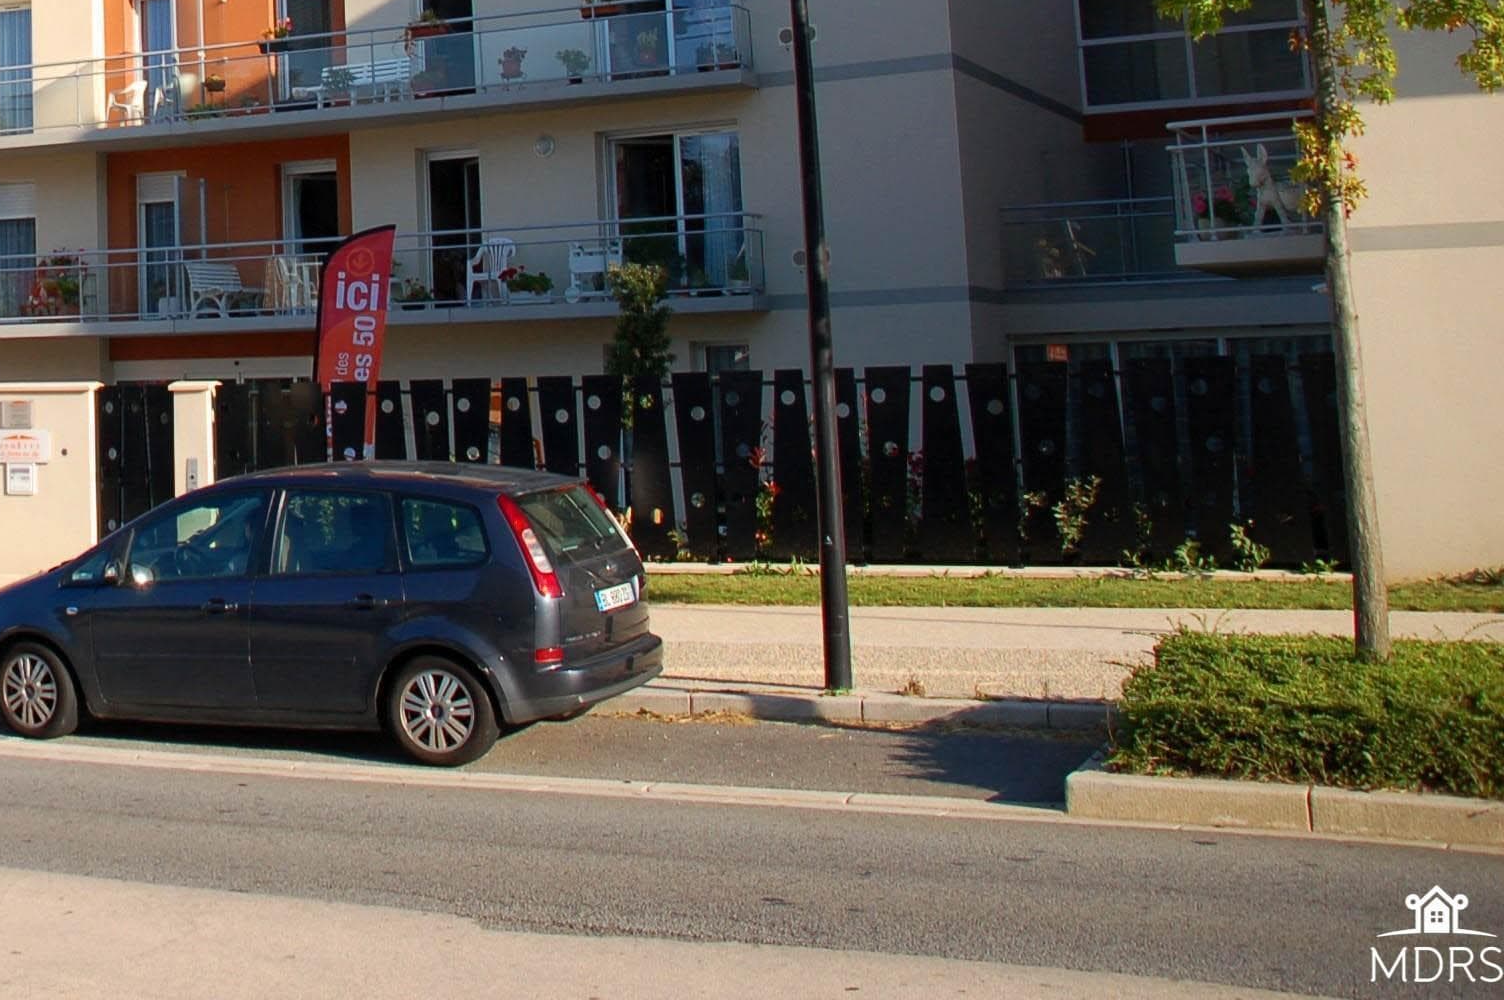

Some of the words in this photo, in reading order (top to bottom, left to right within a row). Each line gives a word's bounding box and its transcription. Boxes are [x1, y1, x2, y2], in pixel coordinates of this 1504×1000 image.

[336, 271, 380, 312] ici
[353, 315, 376, 346] 50
[336, 351, 350, 376] des
